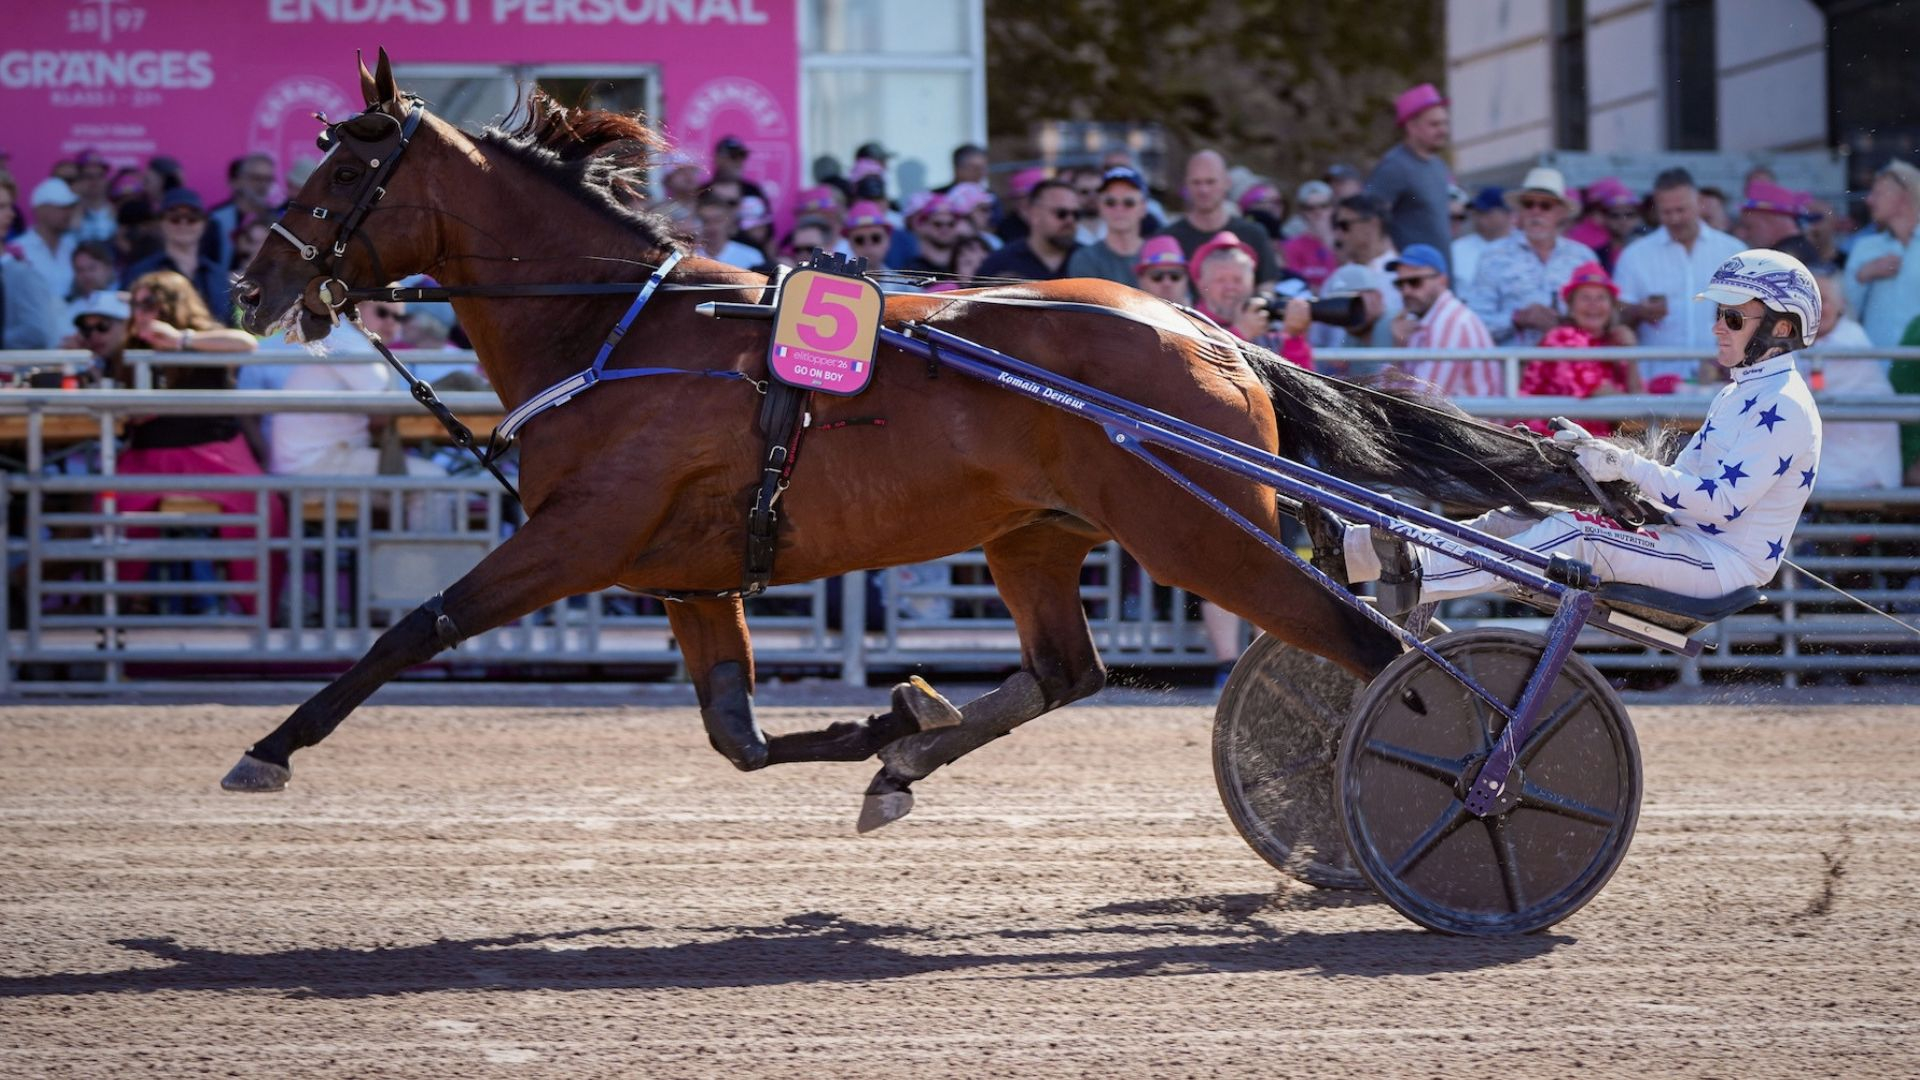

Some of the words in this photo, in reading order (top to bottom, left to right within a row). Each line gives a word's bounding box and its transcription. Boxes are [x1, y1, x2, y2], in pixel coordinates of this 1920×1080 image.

[116, 9, 146, 32] 97
[269, 0, 470, 23] ENDAST
[493, 0, 768, 24] PERSONAL
[0, 50, 213, 89] GRÄNGES
[796, 275, 864, 352] 5
[794, 364, 808, 375] GO
[809, 368, 823, 378] ON
[824, 370, 844, 382] BOY
[998, 371, 1040, 393] Romain
[1042, 387, 1086, 410] Derieux
[1388, 517, 1467, 556] YANKEE
[1614, 533, 1655, 548] NUTRITION
